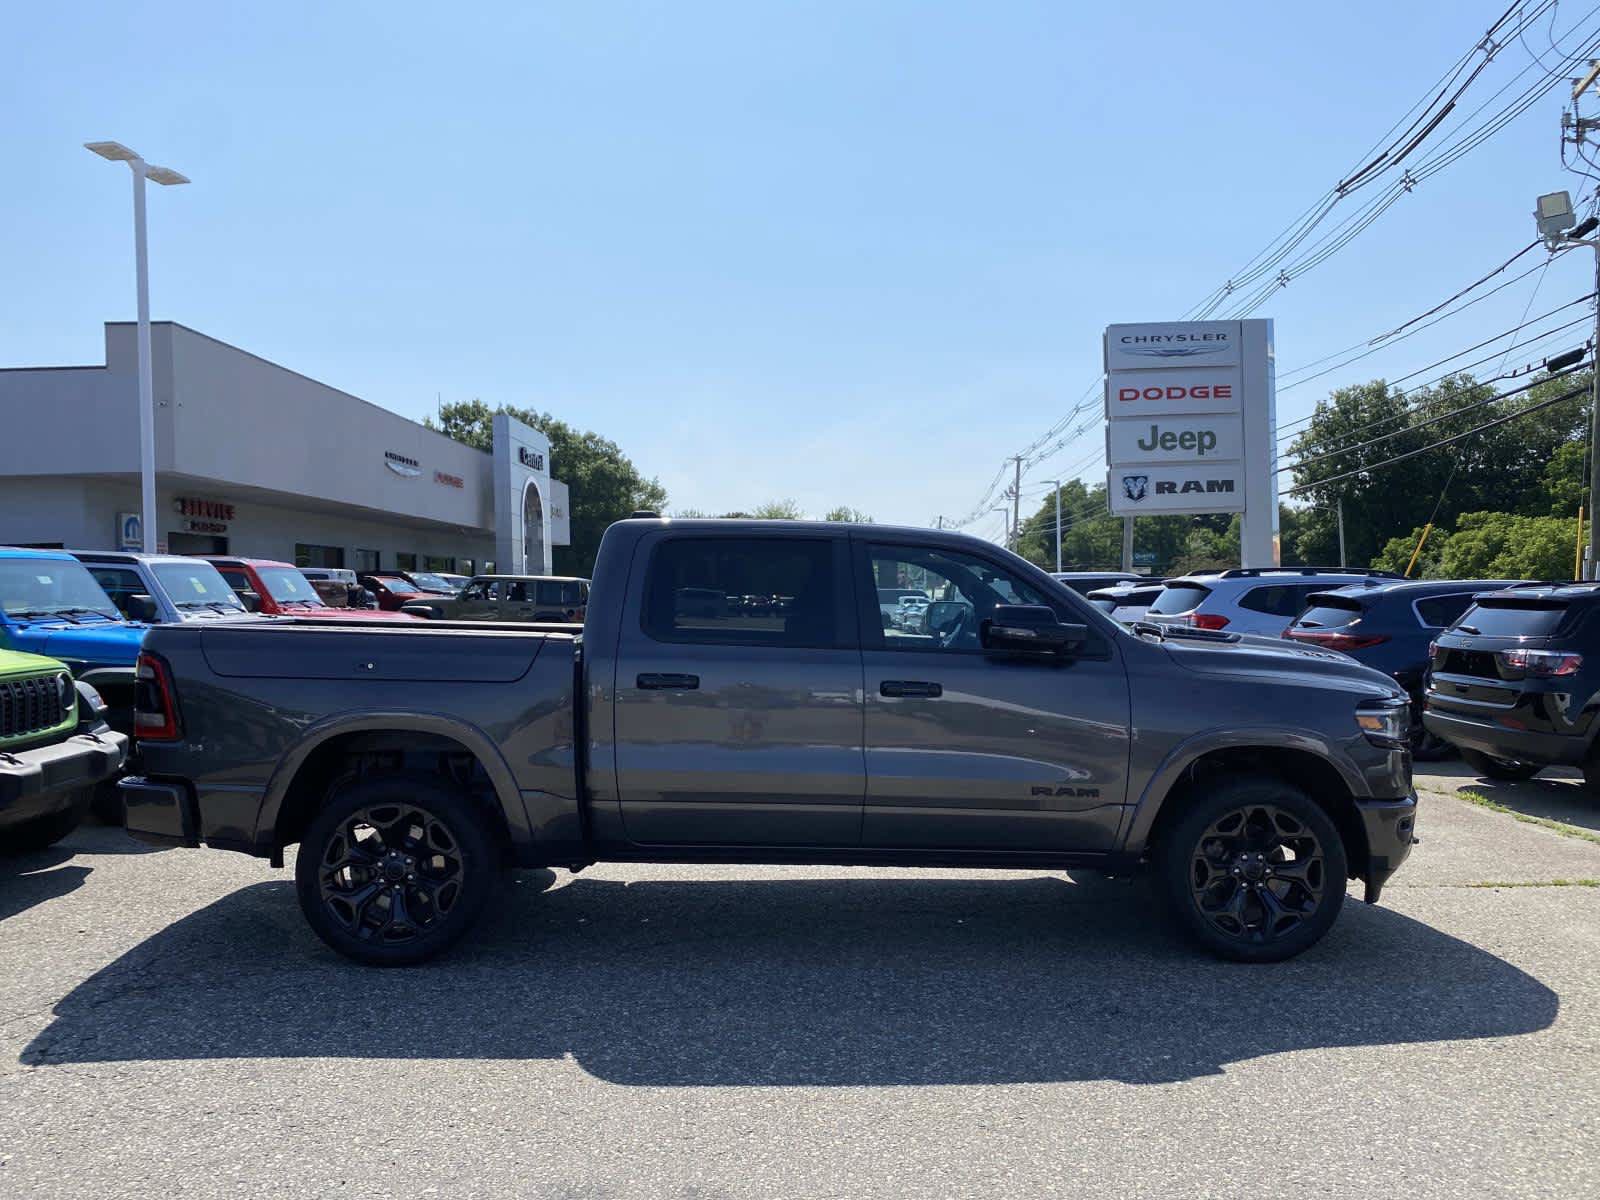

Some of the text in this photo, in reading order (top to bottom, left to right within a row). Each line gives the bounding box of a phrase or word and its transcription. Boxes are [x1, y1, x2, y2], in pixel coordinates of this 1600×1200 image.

[1121, 333, 1228, 344] CHRYSLER
[1119, 385, 1232, 401] DODGE
[1137, 424, 1217, 455] Jeep
[1155, 479, 1235, 495] RAM
[1031, 786, 1100, 798] RAM
